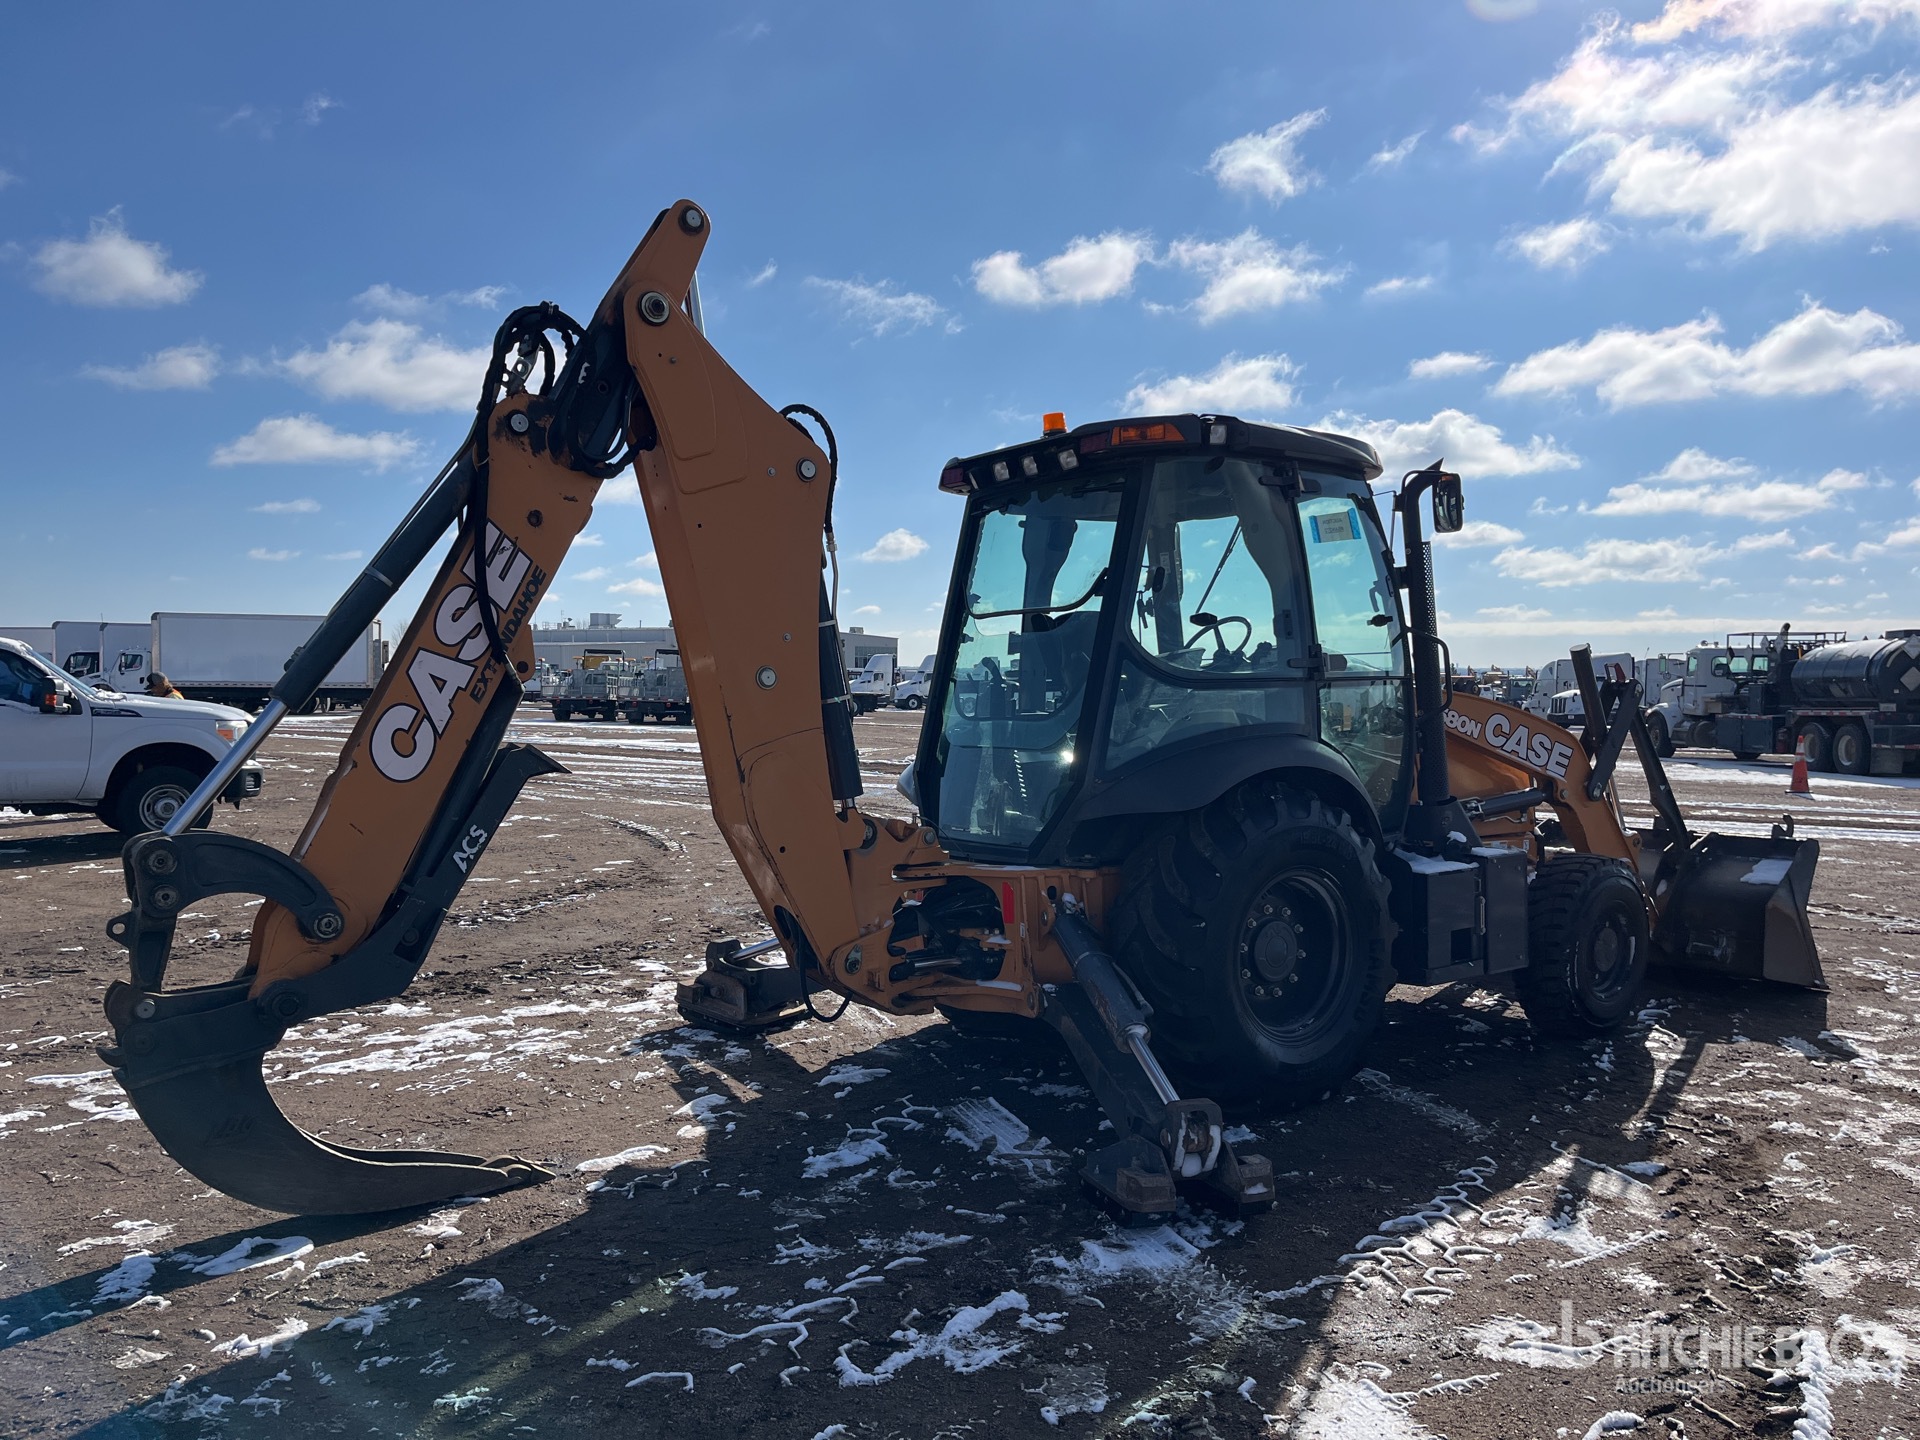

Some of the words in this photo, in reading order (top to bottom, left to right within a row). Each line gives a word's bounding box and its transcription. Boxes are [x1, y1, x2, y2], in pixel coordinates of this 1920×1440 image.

[369, 518, 533, 783] CASE
[470, 565, 547, 705] EXTNDAHOE
[1484, 713, 1574, 778] CASE
[453, 824, 488, 873] ACS
